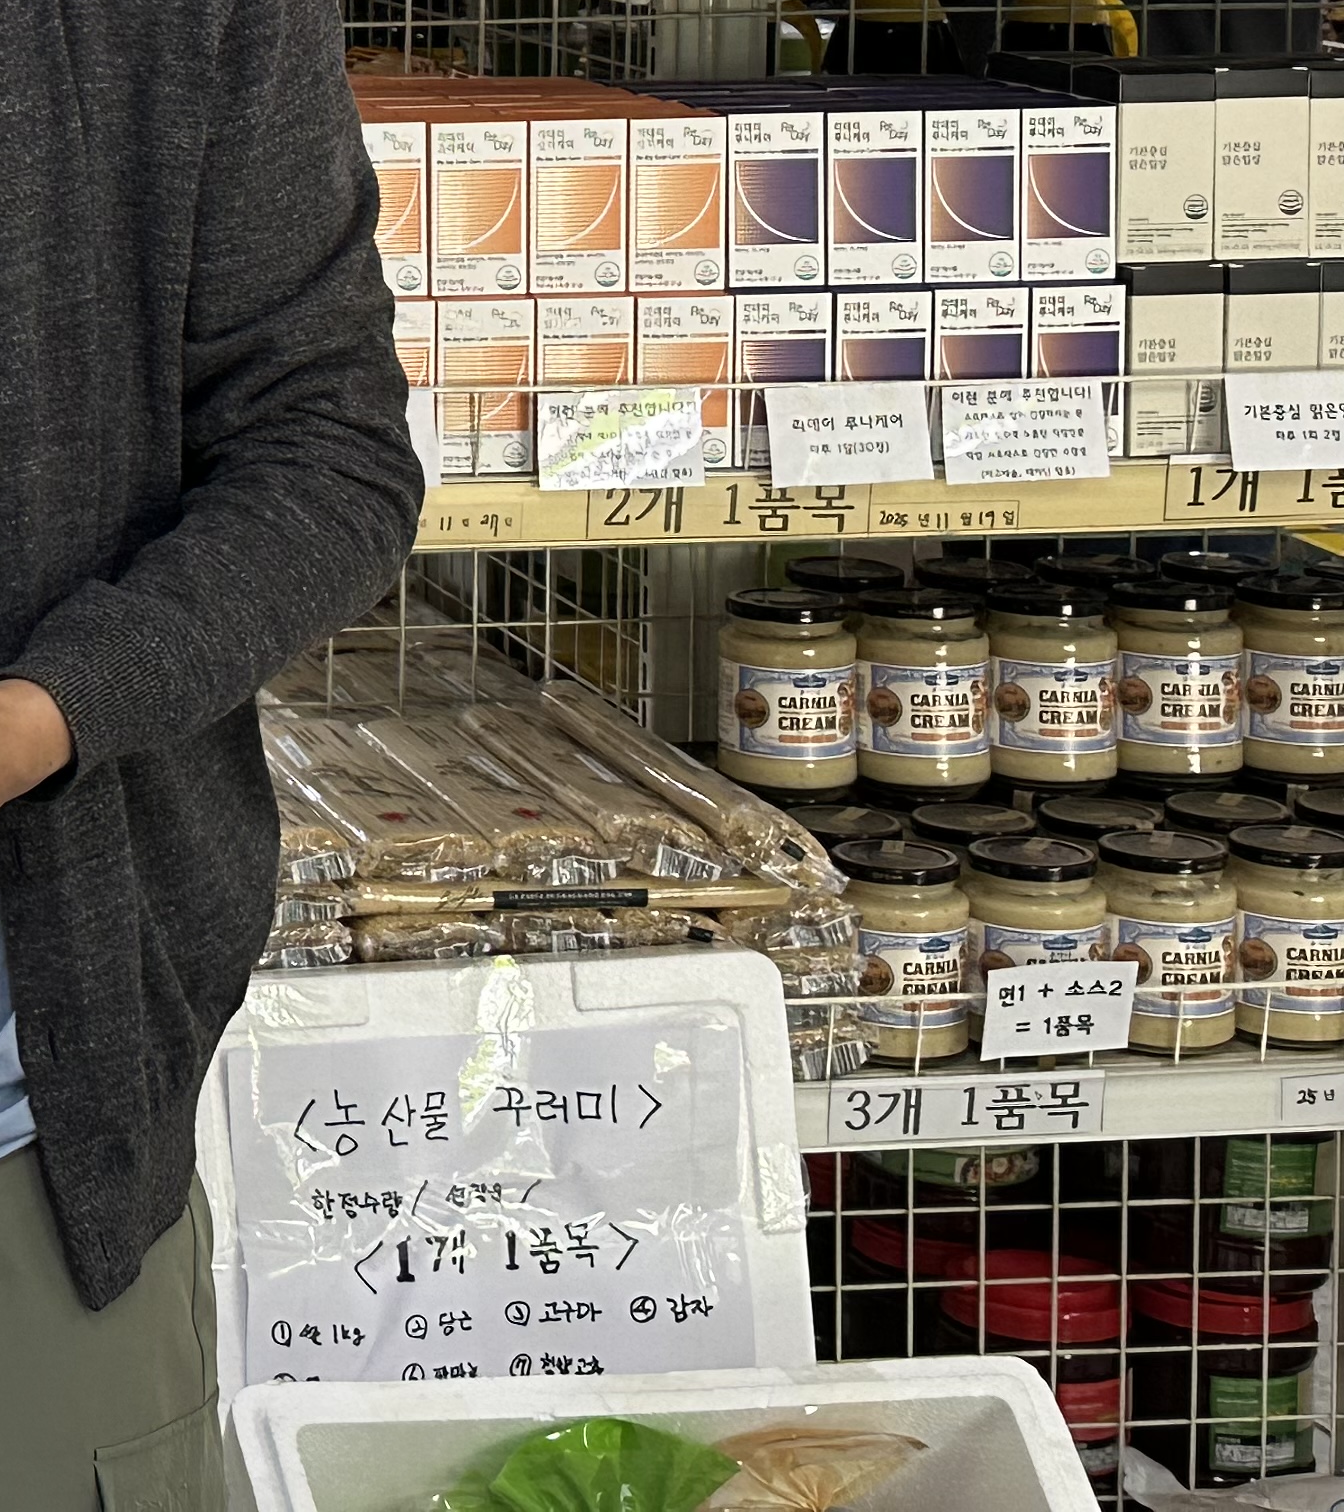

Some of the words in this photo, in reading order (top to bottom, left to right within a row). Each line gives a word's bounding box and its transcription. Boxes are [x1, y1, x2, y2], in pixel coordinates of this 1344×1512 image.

[603, 486, 683, 533] 2개
[723, 483, 855, 533] 1품목
[778, 695, 837, 710] CARNIA
[910, 693, 970, 708] CARNIA
[778, 714, 837, 730] CREAM
[910, 713, 970, 728] CREAM
[1161, 950, 1222, 966] CARNIA
[1064, 979, 1123, 997] 소스2
[1043, 1013, 1095, 1037] 1품목
[844, 1086, 923, 1136] 3개
[961, 1080, 1090, 1130] 1품목
[333, 1322, 366, 1345] 1kg
[438, 1310, 473, 1337] 당근
[539, 1302, 603, 1324] 고구마
[666, 1293, 715, 1322] 감자
